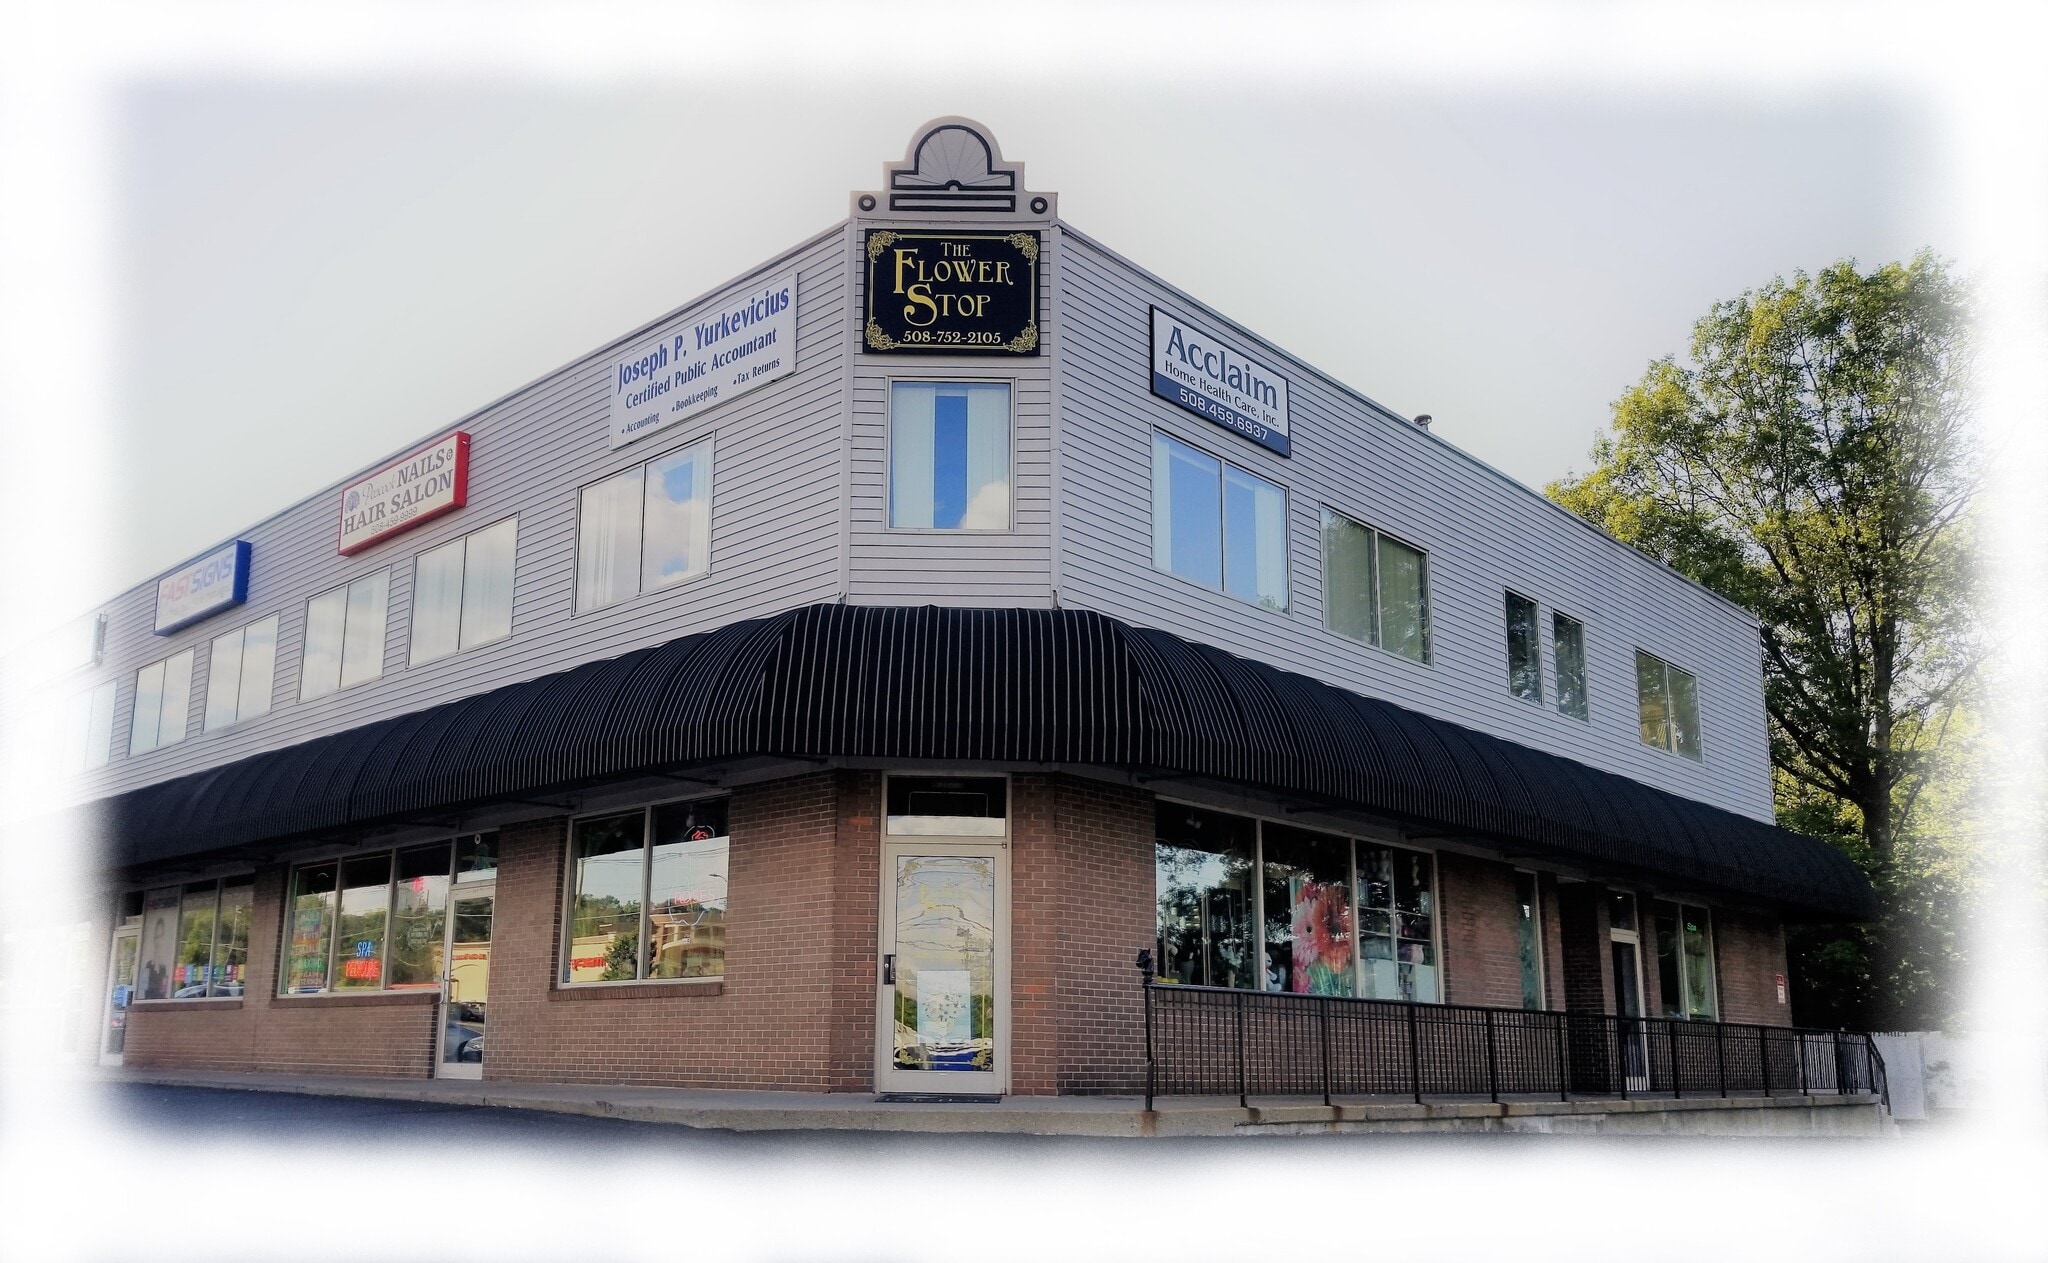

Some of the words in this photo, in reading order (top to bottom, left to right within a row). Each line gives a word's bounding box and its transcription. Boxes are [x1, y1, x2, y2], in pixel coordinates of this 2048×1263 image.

[893, 248, 1014, 294] FLOWER
[940, 242, 971, 257] THE
[903, 283, 991, 326] STOP
[617, 343, 667, 395] Joseph
[674, 335, 687, 361] P.
[695, 287, 789, 351] Yurkevicius
[903, 331, 1001, 344] 508-752-2105
[626, 380, 670, 409] Certified
[675, 360, 707, 387] Public
[711, 327, 777, 371] Accountant
[752, 357, 780, 377] Returns
[1165, 325, 1278, 410] Acclaim
[1165, 360, 1196, 385] Home
[1199, 378, 1232, 404] Health
[1235, 396, 1259, 419] Care,
[1263, 410, 1279, 428] Inc.
[1180, 388, 1268, 440] 508.459.6937
[397, 448, 445, 487] NAILS
[343, 501, 386, 536] HAIR
[390, 468, 454, 514] SALON
[356, 941, 371, 957] SPA
